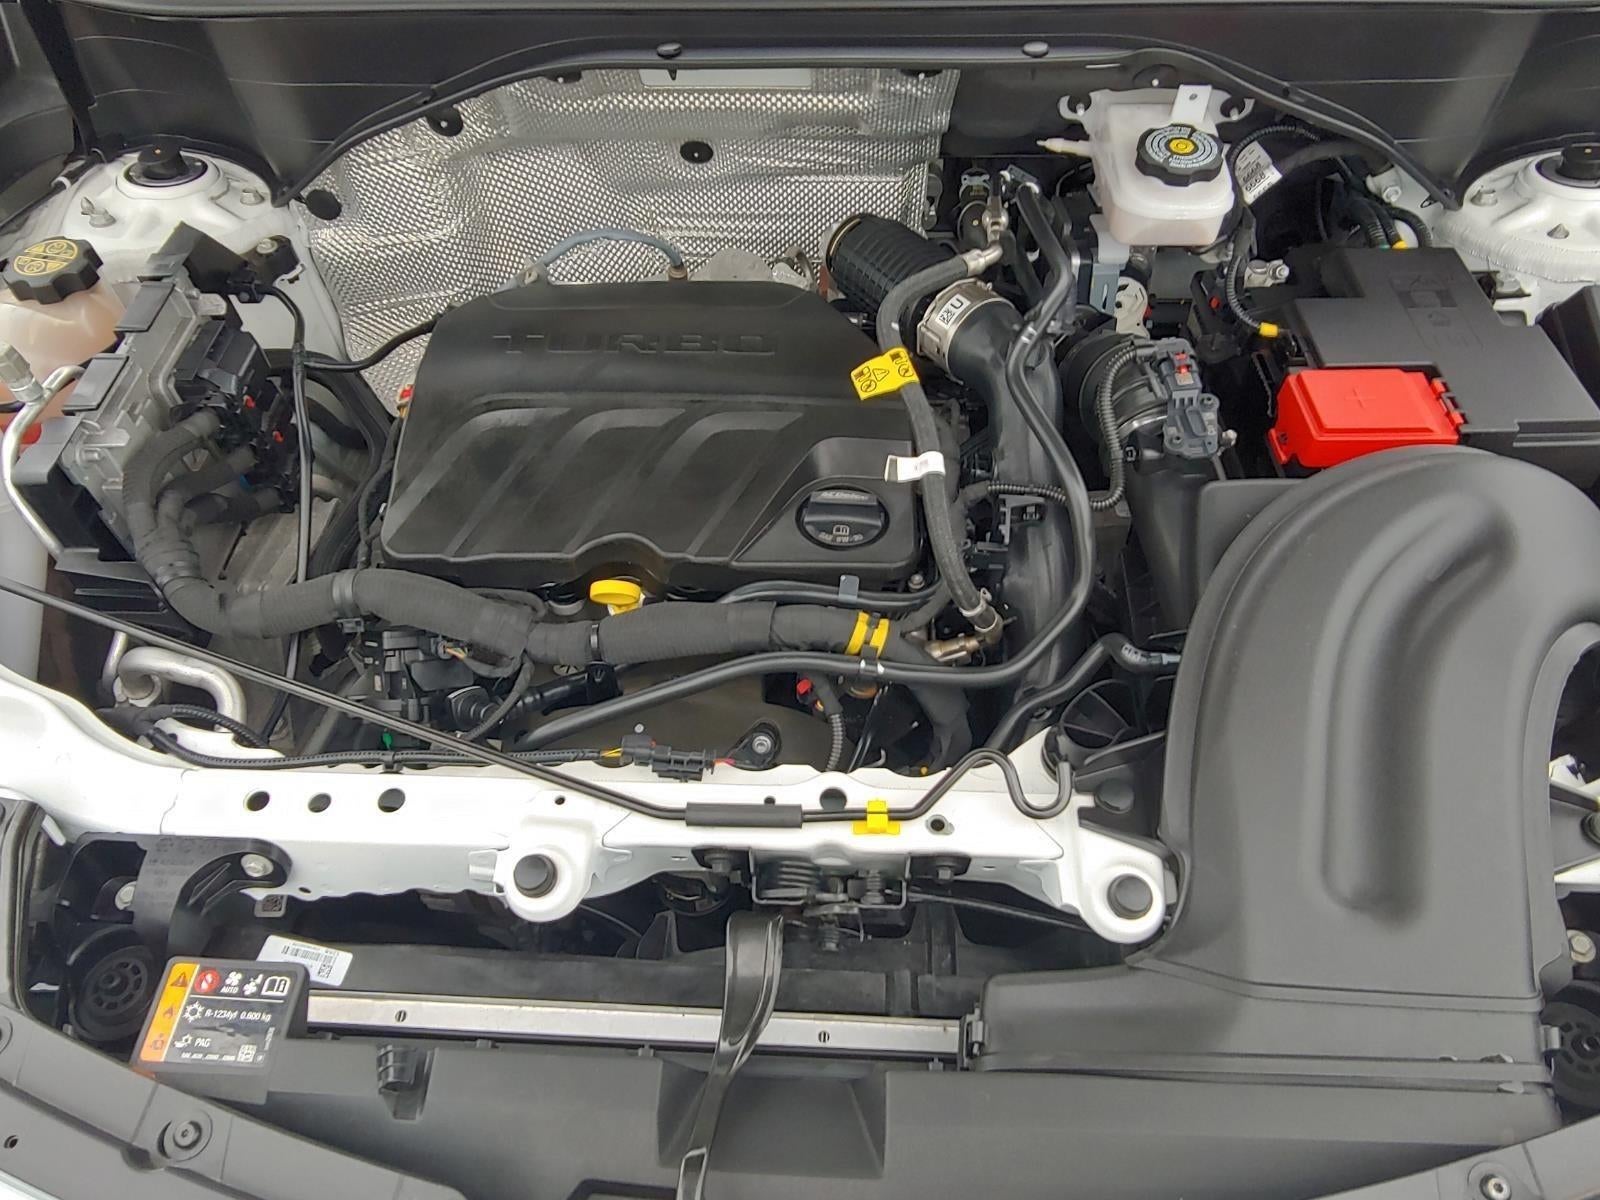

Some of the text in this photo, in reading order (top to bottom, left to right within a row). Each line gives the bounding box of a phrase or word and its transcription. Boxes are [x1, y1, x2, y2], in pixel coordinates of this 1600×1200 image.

[950, 298, 964, 310] U
[491, 334, 776, 355] TURBO
[219, 986, 240, 994] AUTO
[204, 1008, 239, 1020] R-1234yf
[261, 1012, 272, 1023] kg
[194, 1037, 211, 1048] PAG
